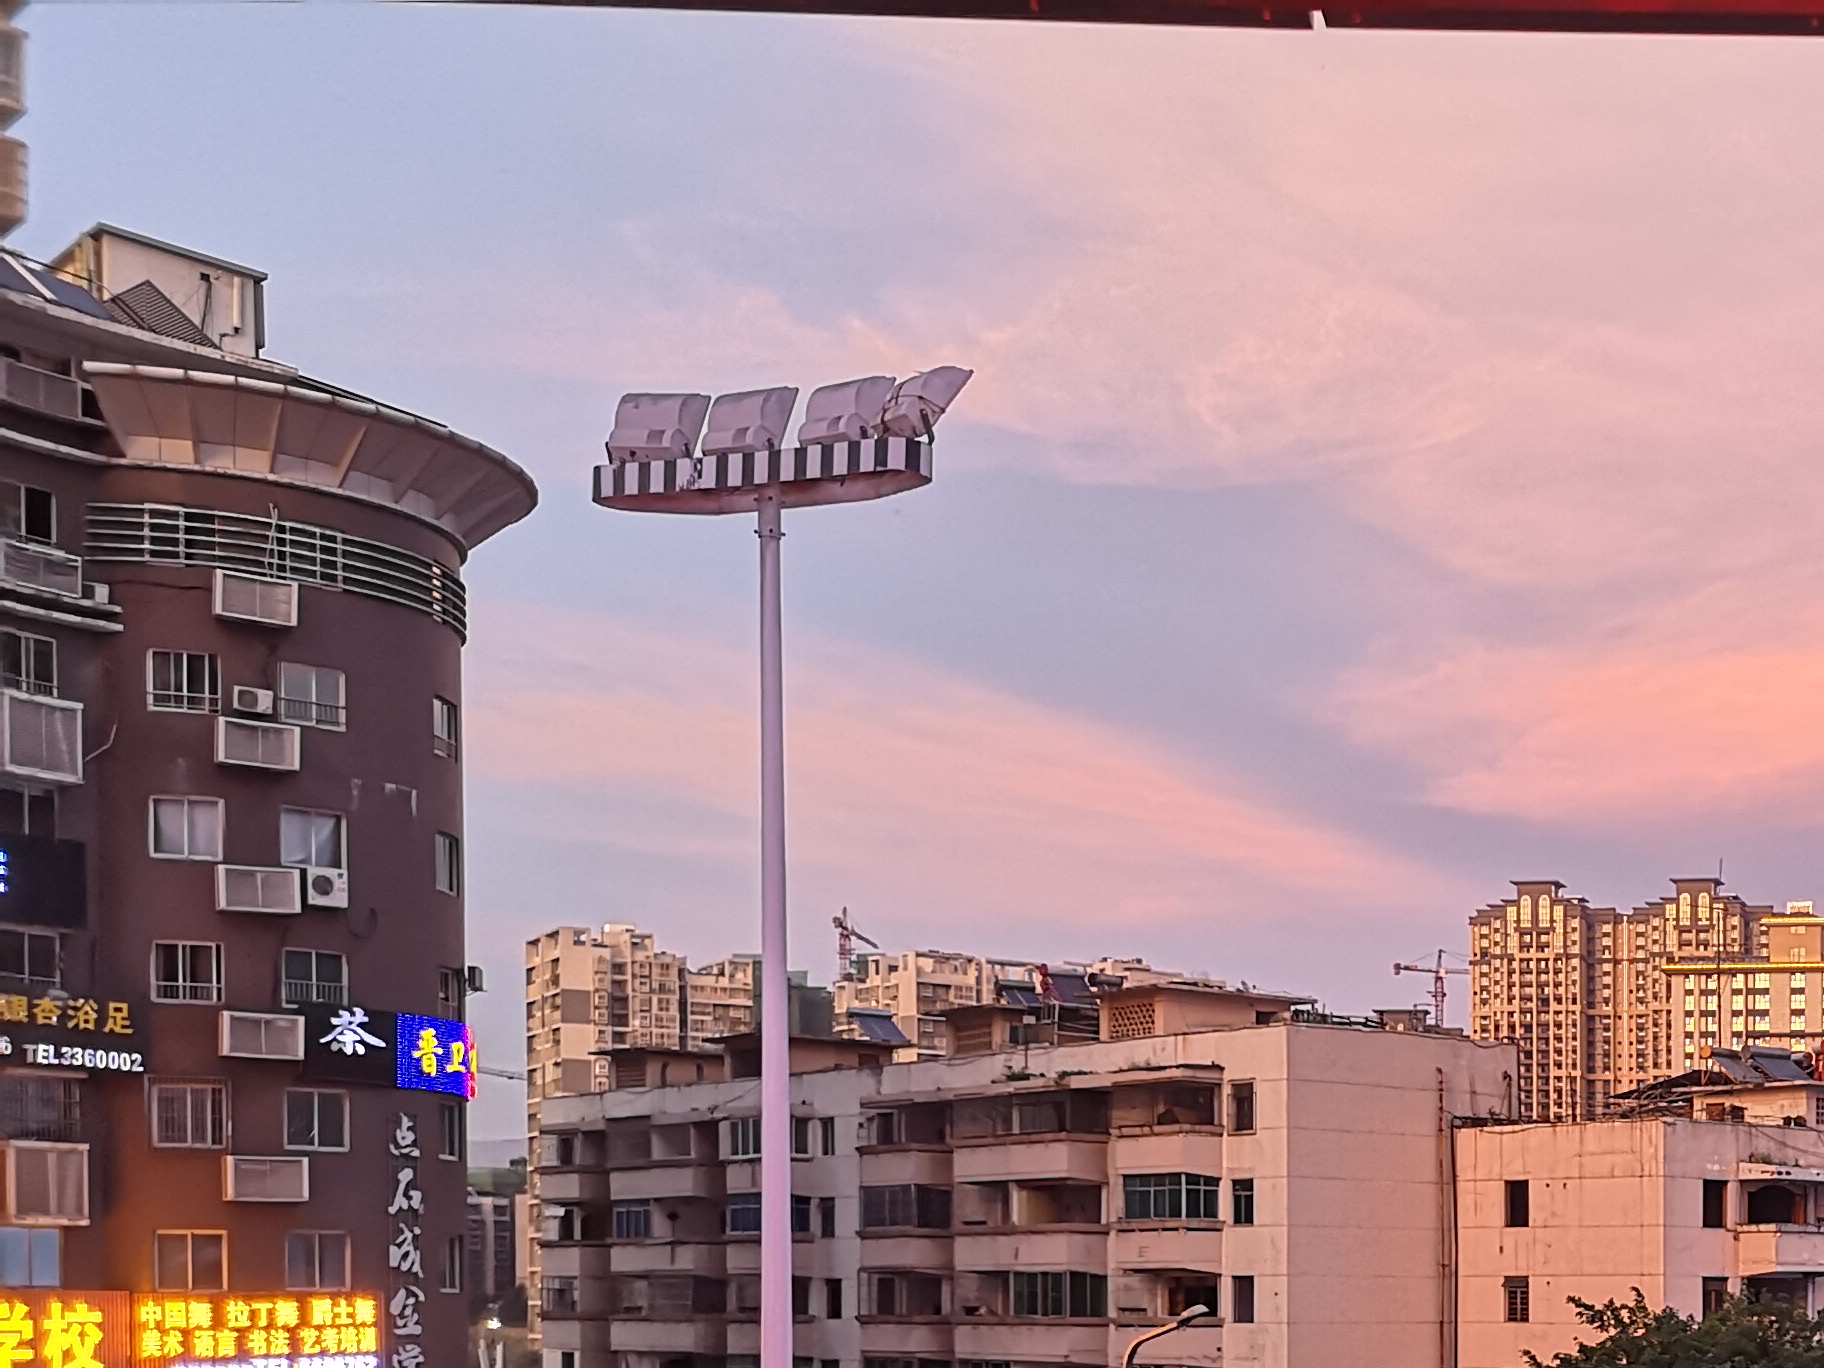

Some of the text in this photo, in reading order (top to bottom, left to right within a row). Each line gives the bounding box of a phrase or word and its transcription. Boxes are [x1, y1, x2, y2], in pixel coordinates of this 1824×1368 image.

[319, 1007, 387, 1055] 茶
[22, 1044, 144, 1072] TEL3360002
[140, 1301, 212, 1329] 中国舞
[227, 1300, 300, 1328] 拉丁舞
[142, 1327, 377, 1357] 美术 语言 书法 艺考培训
